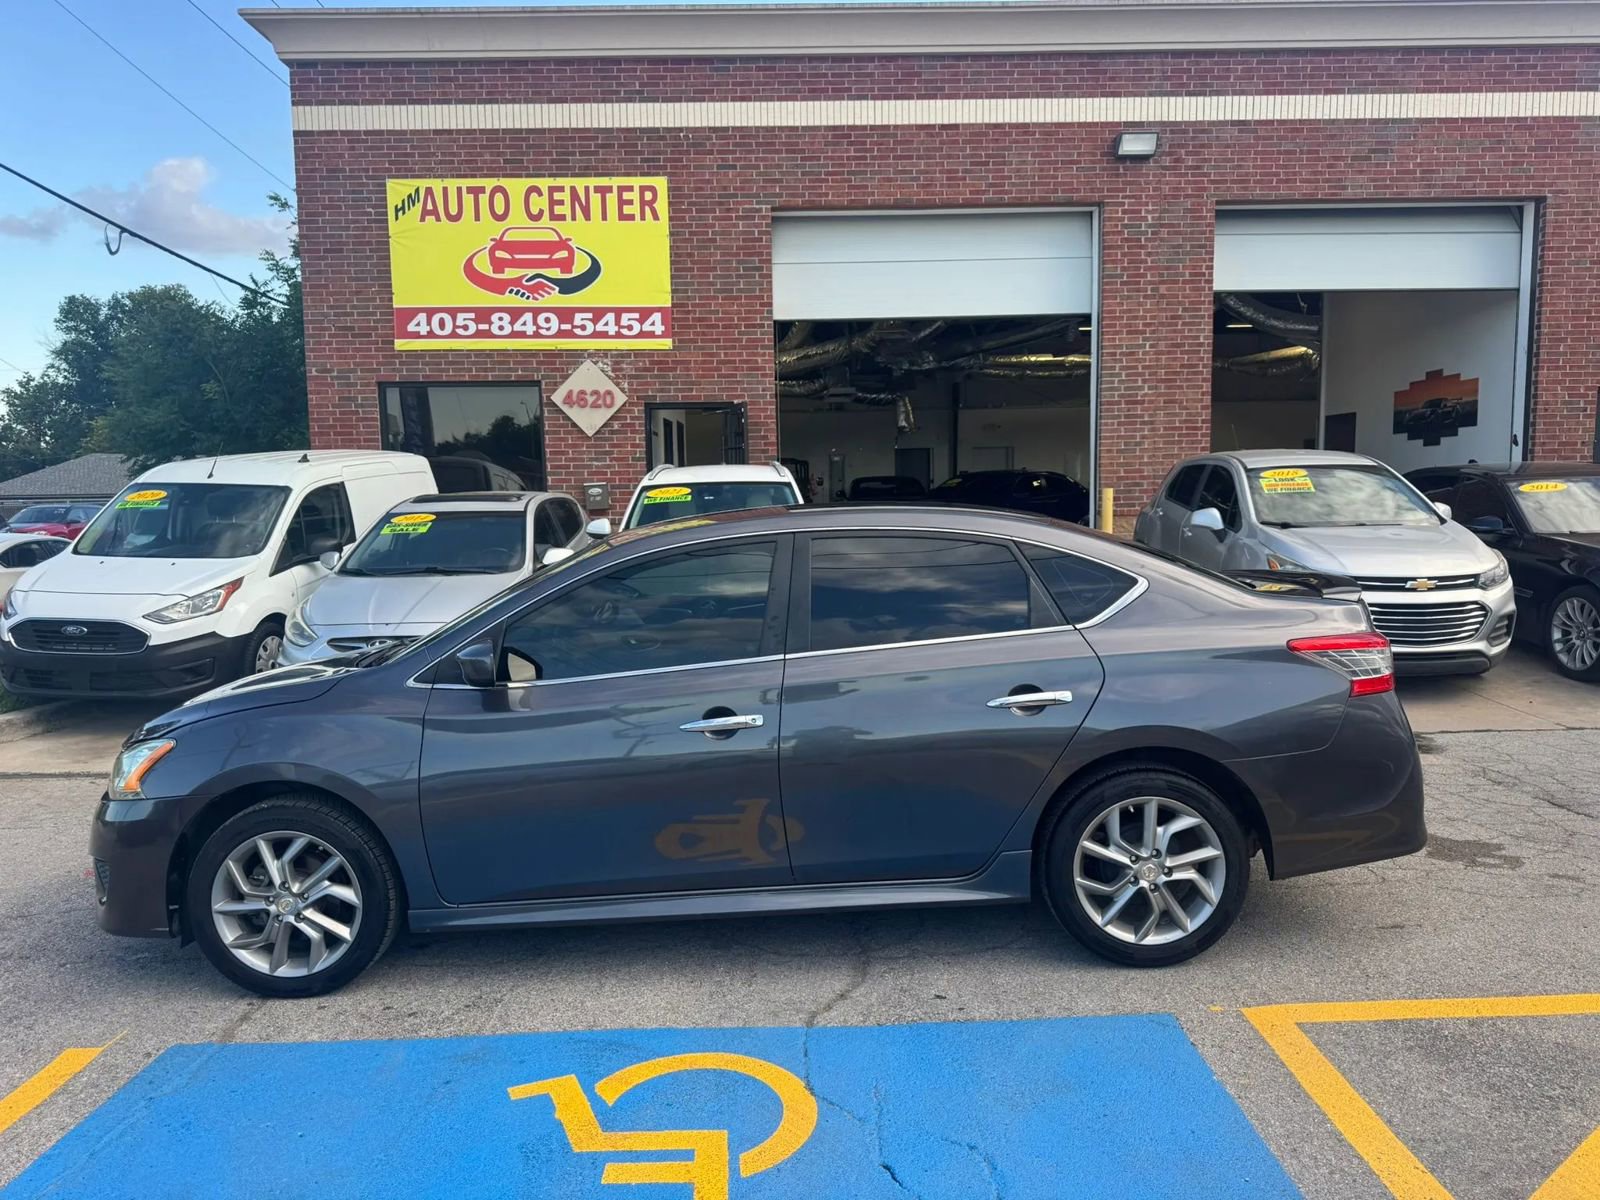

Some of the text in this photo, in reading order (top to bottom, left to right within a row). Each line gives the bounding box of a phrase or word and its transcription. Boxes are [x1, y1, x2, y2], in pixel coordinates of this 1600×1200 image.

[394, 184, 660, 223] HM AUTO CENTER
[406, 311, 665, 336] 405-849-5454
[562, 389, 615, 409] 4620
[1528, 483, 1559, 491] 2014
